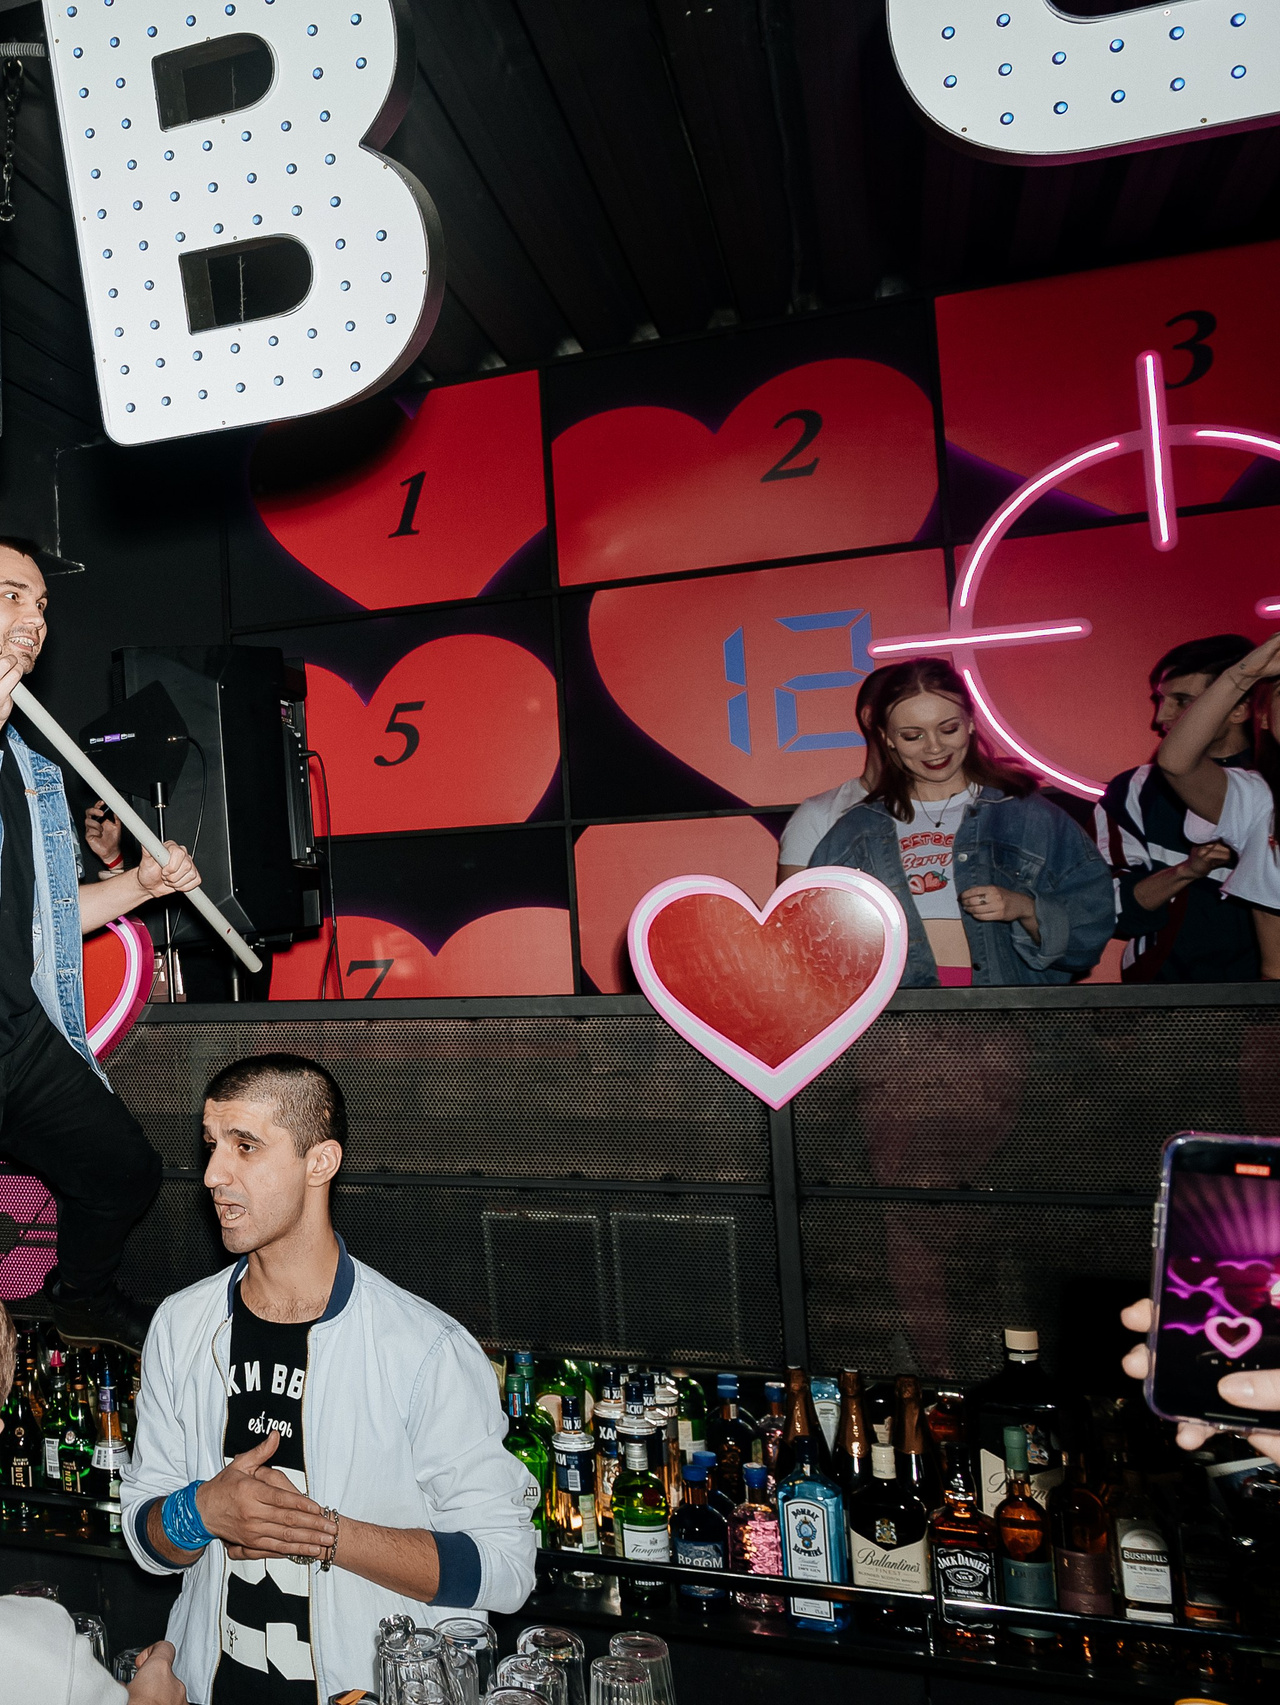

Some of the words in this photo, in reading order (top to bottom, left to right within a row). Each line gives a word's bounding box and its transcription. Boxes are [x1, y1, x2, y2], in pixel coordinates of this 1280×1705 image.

[1162, 309, 1218, 390] 3
[759, 408, 825, 483] 2
[386, 471, 428, 540] 1
[723, 608, 875, 756] 12
[373, 700, 426, 768] 5
[345, 958, 395, 999] 7
[791, 1507, 819, 1522] BOMBAY
[792, 1543, 823, 1558] SAPPHIRE
[856, 1547, 921, 1574] Ballantine's
[937, 1556, 958, 1570] JACK
[957, 1552, 992, 1576] DANIEL'S
[1123, 1550, 1168, 1563] BUSHMILLS
